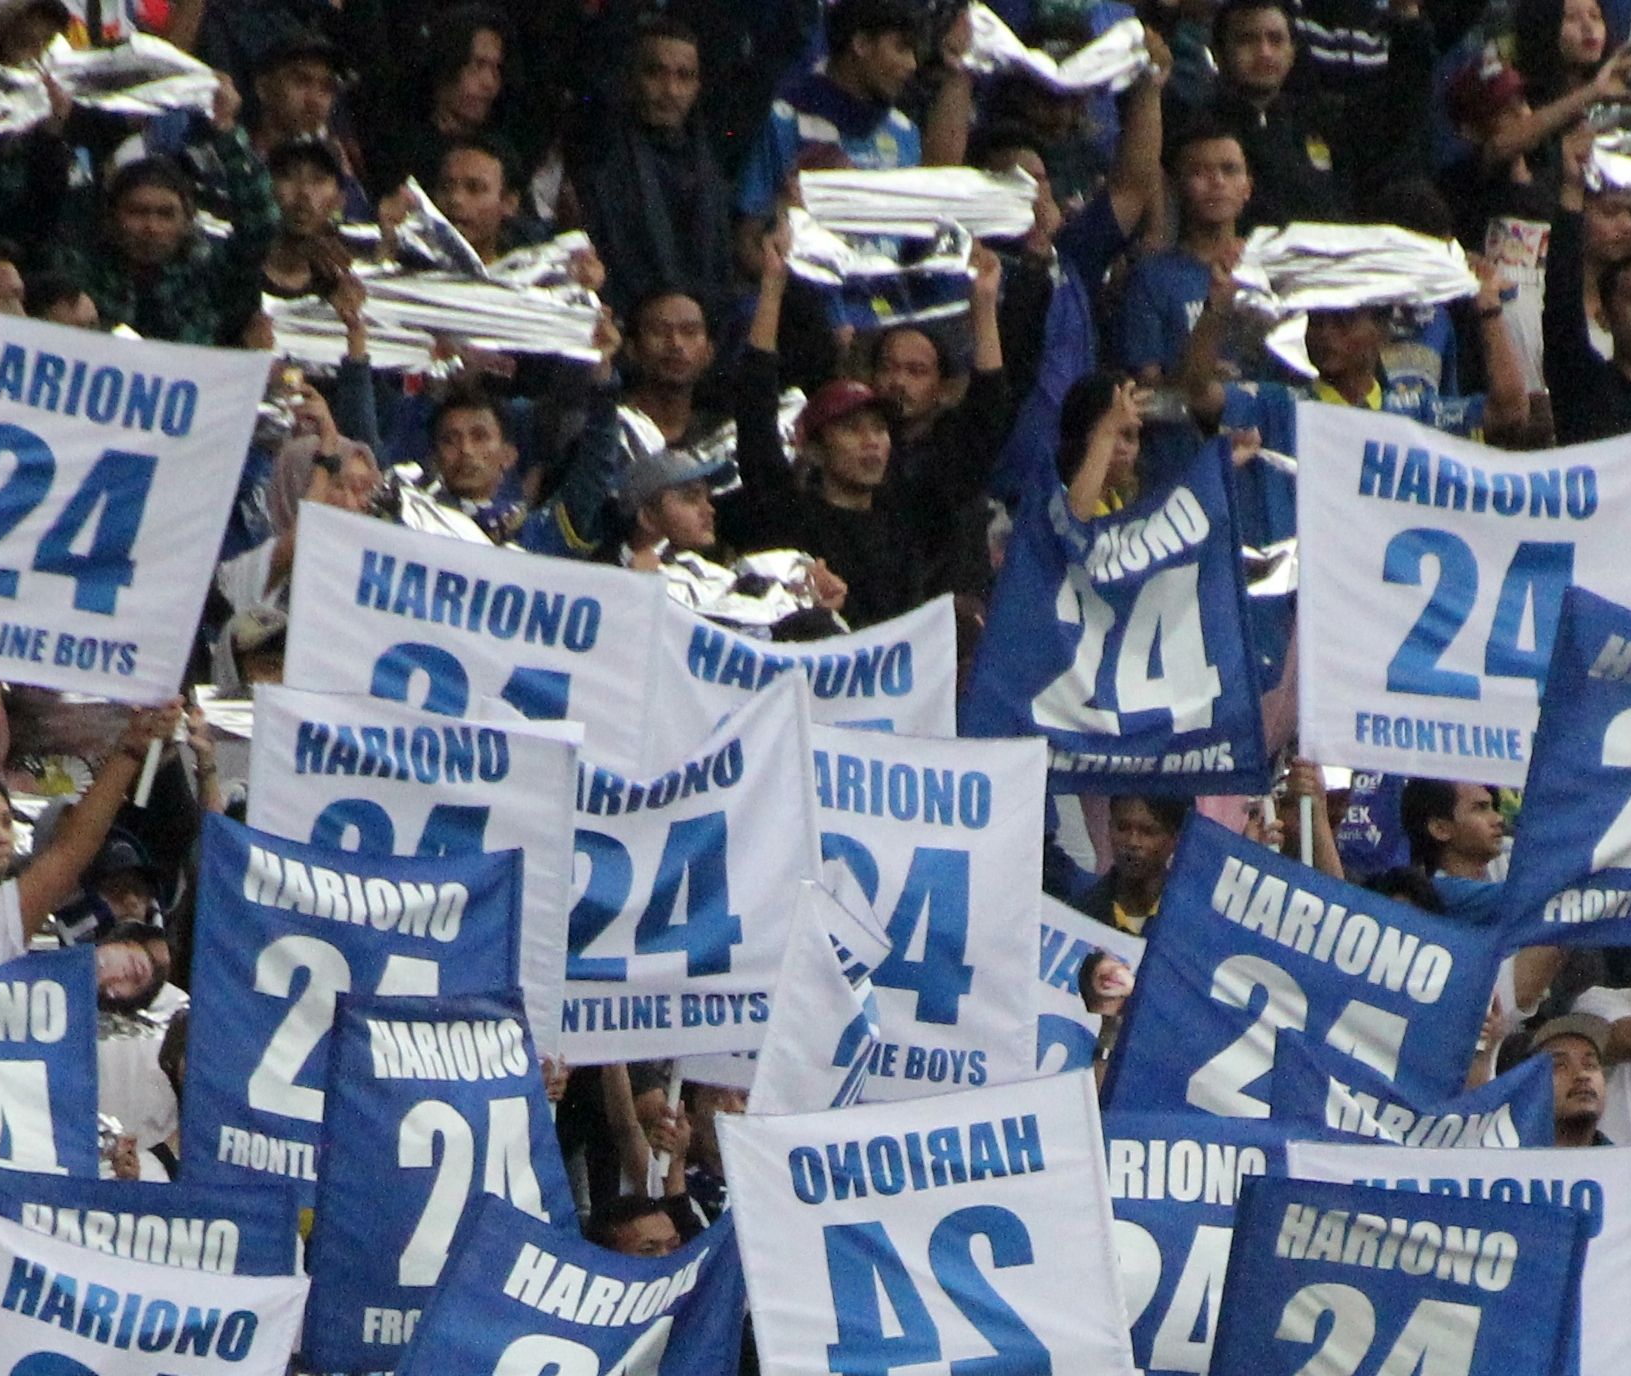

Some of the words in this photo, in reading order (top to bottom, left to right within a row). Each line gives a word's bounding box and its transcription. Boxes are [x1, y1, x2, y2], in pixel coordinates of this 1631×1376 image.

[1359, 439, 1599, 521] HARIONO
[357, 550, 603, 654] HARIONO
[1382, 527, 1575, 707] 24
[55, 632, 139, 676] BOYS
[1031, 561, 1222, 737] 24
[294, 719, 510, 784] HARIONO
[1355, 712, 1524, 763] FRONTLINE
[244, 845, 470, 943] HARIONO
[566, 810, 744, 981] 24
[1213, 855, 1455, 1004] HARIONO
[367, 1019, 531, 1082] HARIONO
[680, 990, 770, 1030] BOYS
[904, 1045, 988, 1087] BOYS
[1275, 1202, 1519, 1293] HARIONO
[0, 1255, 261, 1363] HARIONO
